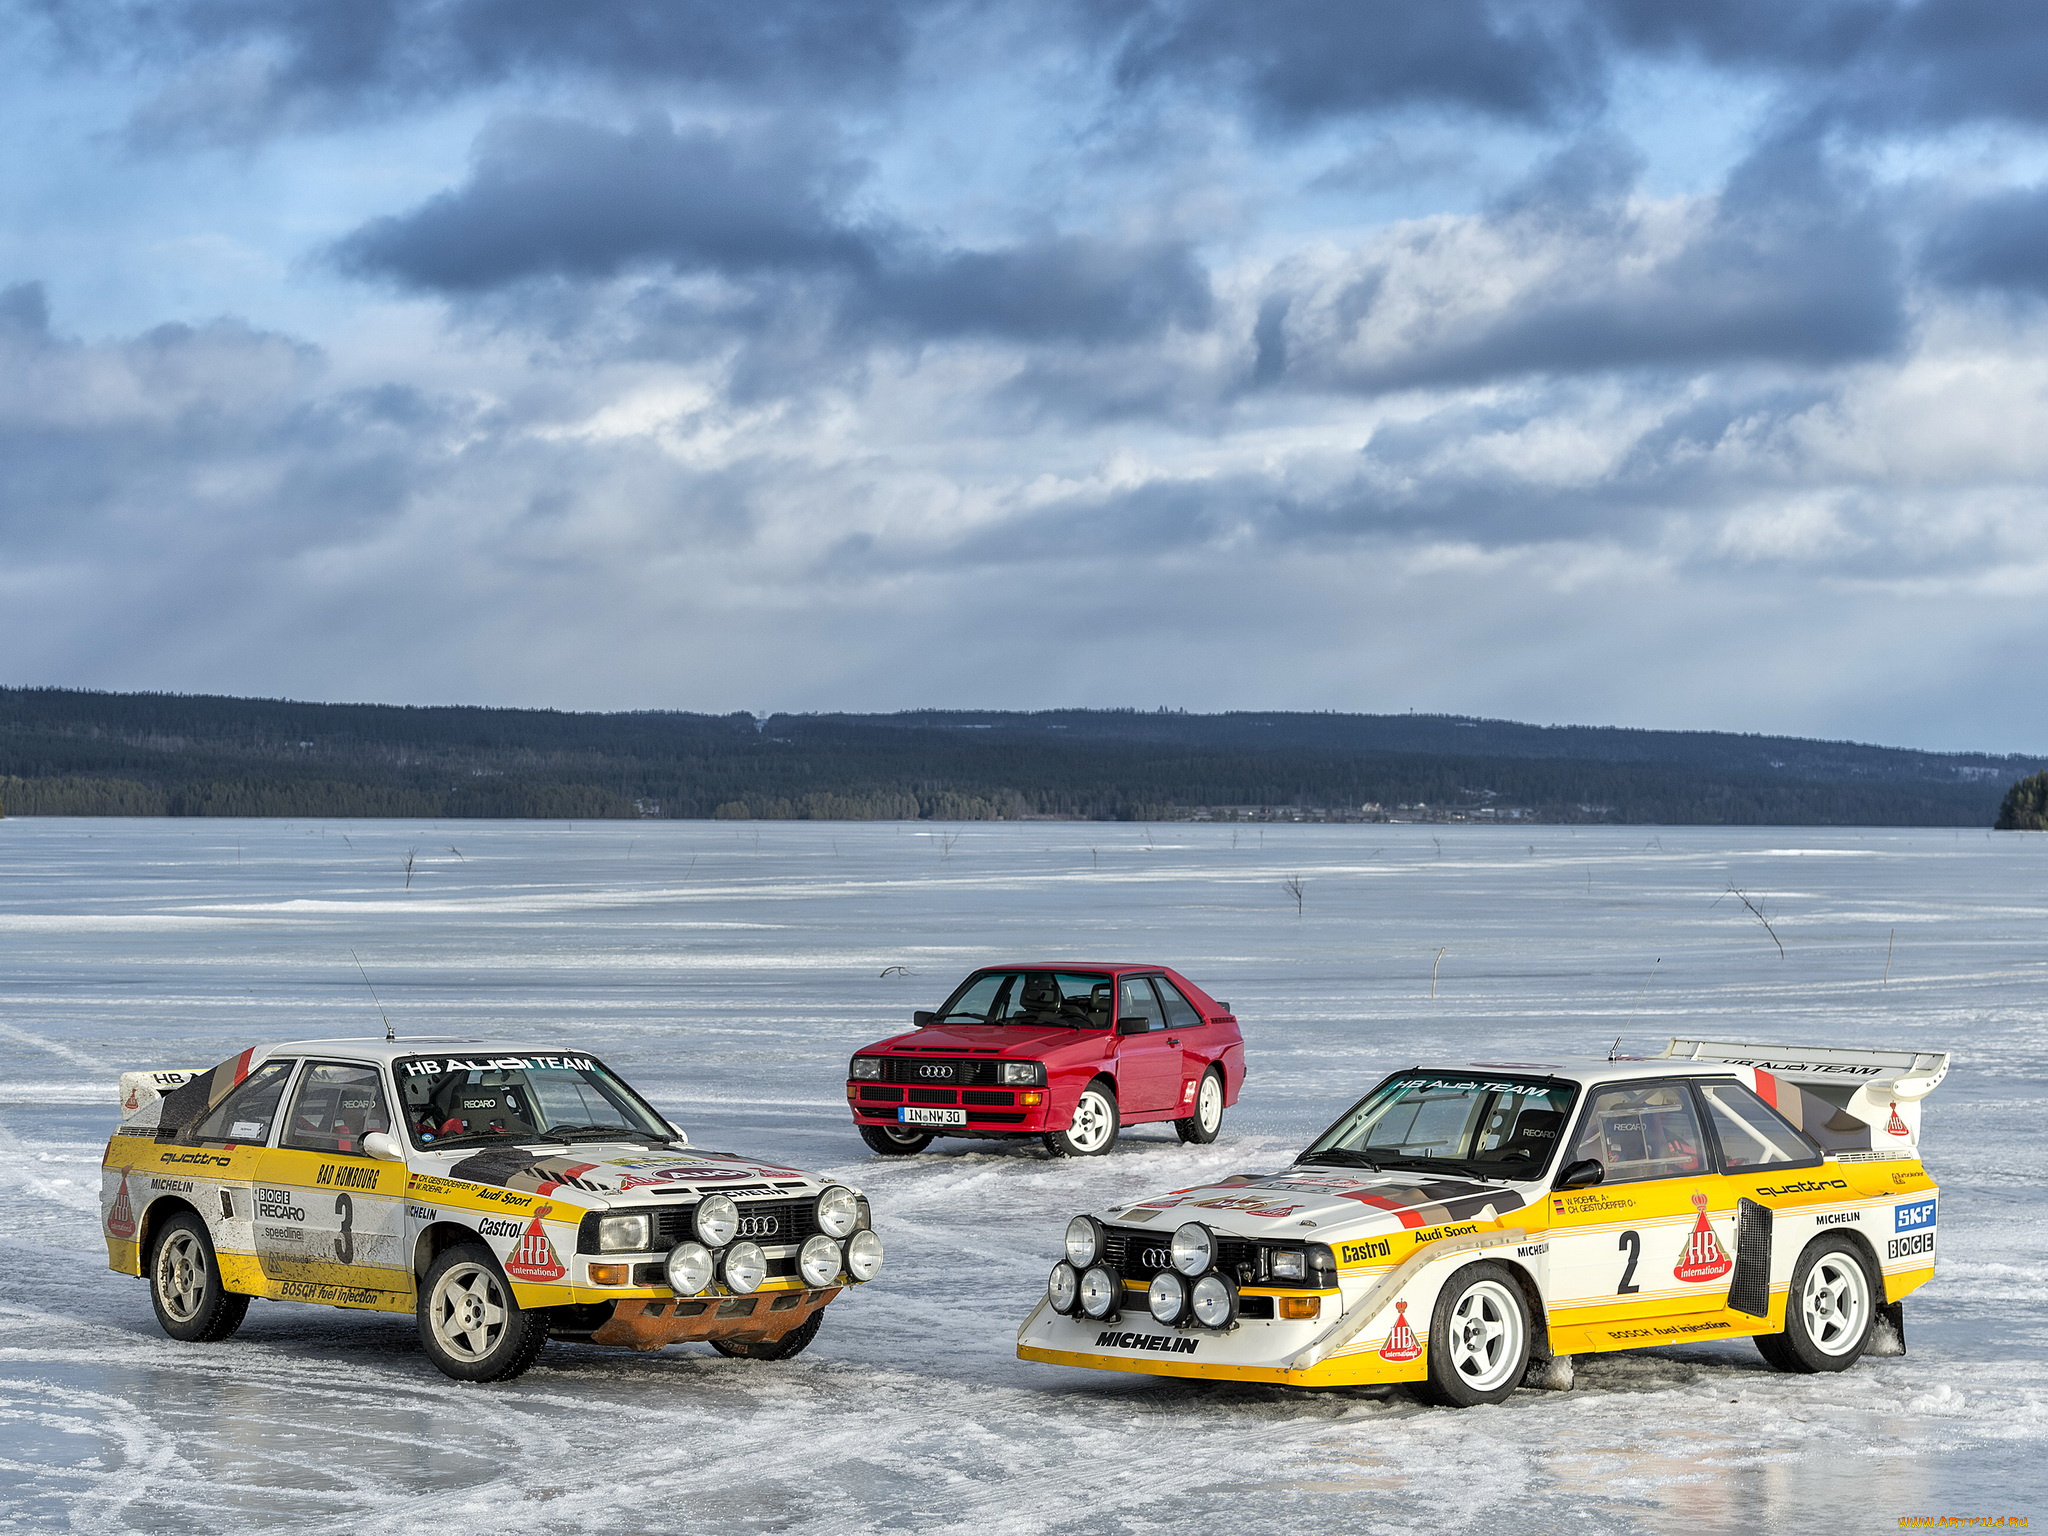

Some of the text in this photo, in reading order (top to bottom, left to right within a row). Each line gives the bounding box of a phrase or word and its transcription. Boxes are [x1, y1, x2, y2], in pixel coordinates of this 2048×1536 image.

[405, 1060, 442, 1077] HB
[530, 1056, 596, 1072] TEAM
[1812, 1065, 1883, 1075] TEAM
[153, 1073, 185, 1084] HB
[1392, 1080, 1427, 1090] HB
[1479, 1082, 1550, 1097] TEAM
[464, 1099, 496, 1109] RECARO
[909, 1109, 922, 1121] IN
[929, 1110, 944, 1122] NW
[946, 1111, 960, 1122] 30
[1523, 1129, 1556, 1139] RECARO
[160, 1153, 231, 1167] quattro
[151, 1178, 194, 1193] MICHELIN
[316, 1164, 380, 1189] BAD HOMBOURG
[259, 1188, 290, 1205] BOGE
[476, 1188, 533, 1208] Audi Sport
[1756, 1178, 1847, 1198] quattro
[260, 1204, 305, 1222] RECARO
[1816, 1211, 1860, 1226] MICHELIN
[1898, 1204, 1934, 1227] SKF
[334, 1192, 354, 1265] 3
[478, 1217, 523, 1239] Castrol
[1414, 1224, 1478, 1244] Audi Sport
[518, 1233, 551, 1267] HB
[1341, 1238, 1391, 1264] Castrol
[1688, 1230, 1719, 1266] HB
[1888, 1233, 1933, 1259] BOGE
[512, 1265, 558, 1278] international
[1617, 1230, 1640, 1295] 2
[1681, 1263, 1725, 1278] international
[281, 1282, 378, 1305] BOSCH fuel injection
[1391, 1326, 1412, 1349] HB
[1607, 1321, 1731, 1339] BOSCH fuel injection
[1095, 1331, 1200, 1354] MICHELIN
